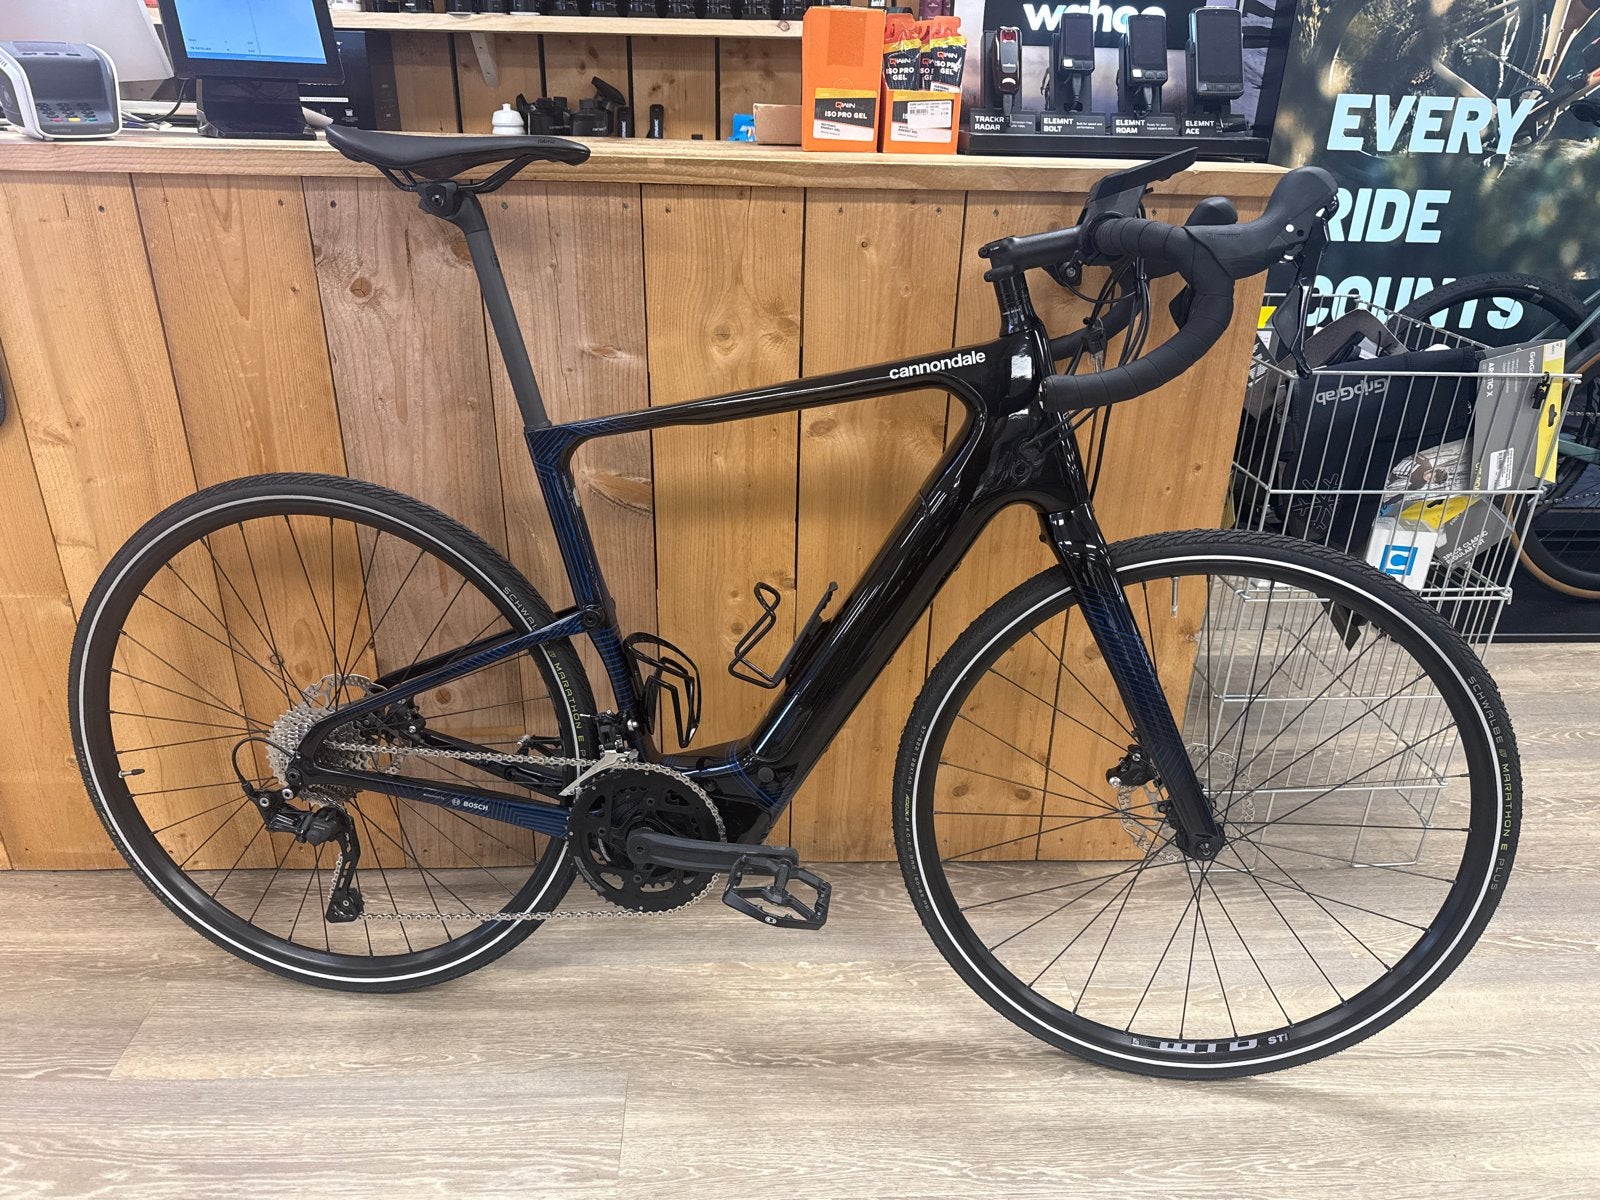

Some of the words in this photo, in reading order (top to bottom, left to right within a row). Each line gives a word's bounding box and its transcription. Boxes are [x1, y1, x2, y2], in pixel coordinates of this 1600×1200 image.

[835, 101, 856, 110] QWIN
[837, 111, 853, 119] PRO
[853, 112, 868, 120] GEL
[974, 115, 1005, 123] TRACKR
[1043, 117, 1074, 125] ELEMNT
[974, 123, 1001, 131] RADAR
[1043, 125, 1063, 133] BOLT
[1326, 93, 1540, 155] EVERY
[889, 350, 986, 380] cannondale
[1315, 378, 1388, 406] GripGrab
[553, 661, 582, 729] MARATHON
[1467, 675, 1504, 744] SCHWALBE
[463, 800, 489, 811] BOSCH
[1502, 763, 1513, 837] MARATHON
[1500, 843, 1508, 851] E
[1490, 858, 1505, 890] PLUS
